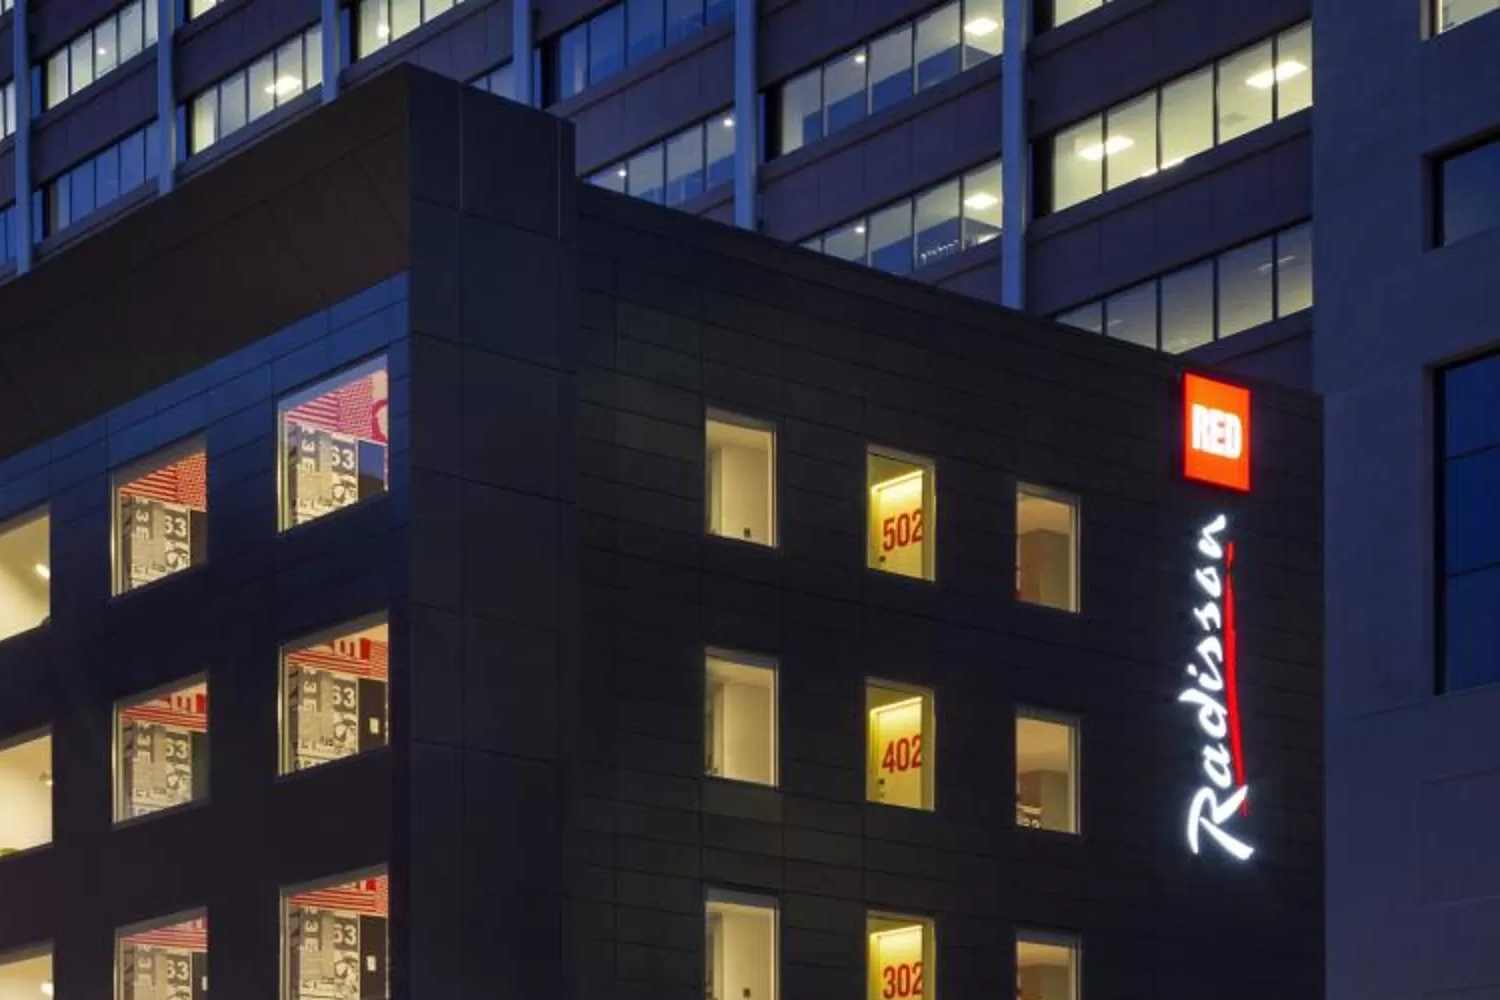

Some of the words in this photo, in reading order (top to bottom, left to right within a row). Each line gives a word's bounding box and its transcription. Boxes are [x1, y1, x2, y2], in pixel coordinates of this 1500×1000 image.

[1191, 402, 1243, 459] RED
[883, 507, 925, 552] 502
[1178, 514, 1254, 861] Radisson
[882, 734, 923, 774] 402
[883, 961, 925, 1000] 302
